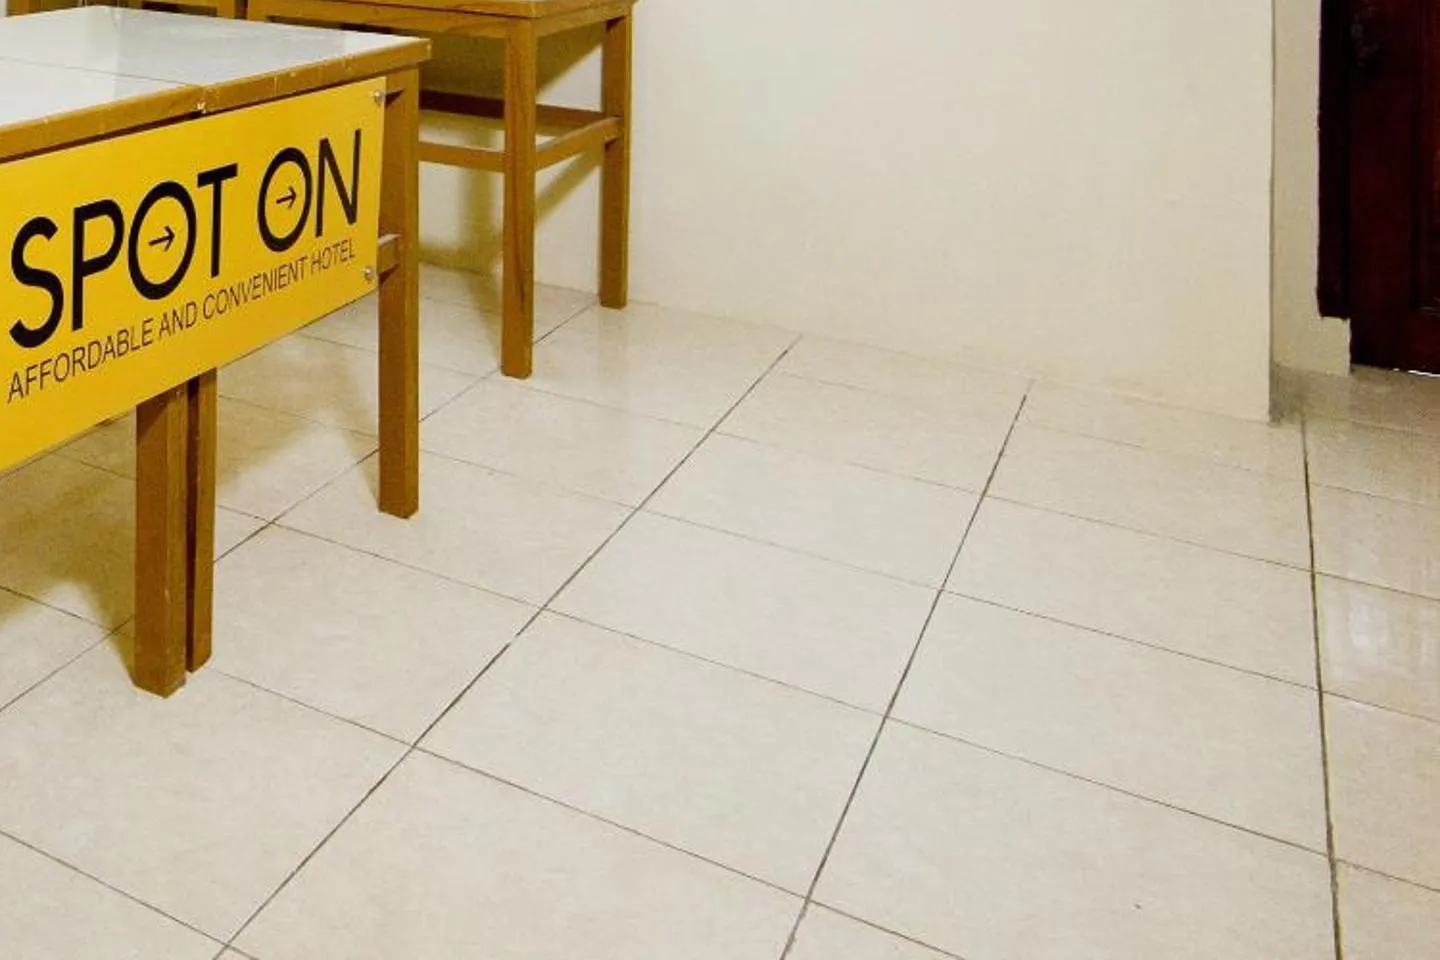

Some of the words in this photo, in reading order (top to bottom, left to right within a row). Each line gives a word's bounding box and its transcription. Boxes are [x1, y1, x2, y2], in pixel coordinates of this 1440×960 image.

[8, 318, 154, 403] AFFORDABLE
[159, 301, 197, 337] AND
[203, 256, 307, 319] CONVENIENT
[310, 238, 355, 274] HOTEL
[9, 163, 238, 349] SPOT
[257, 128, 362, 252] ON
